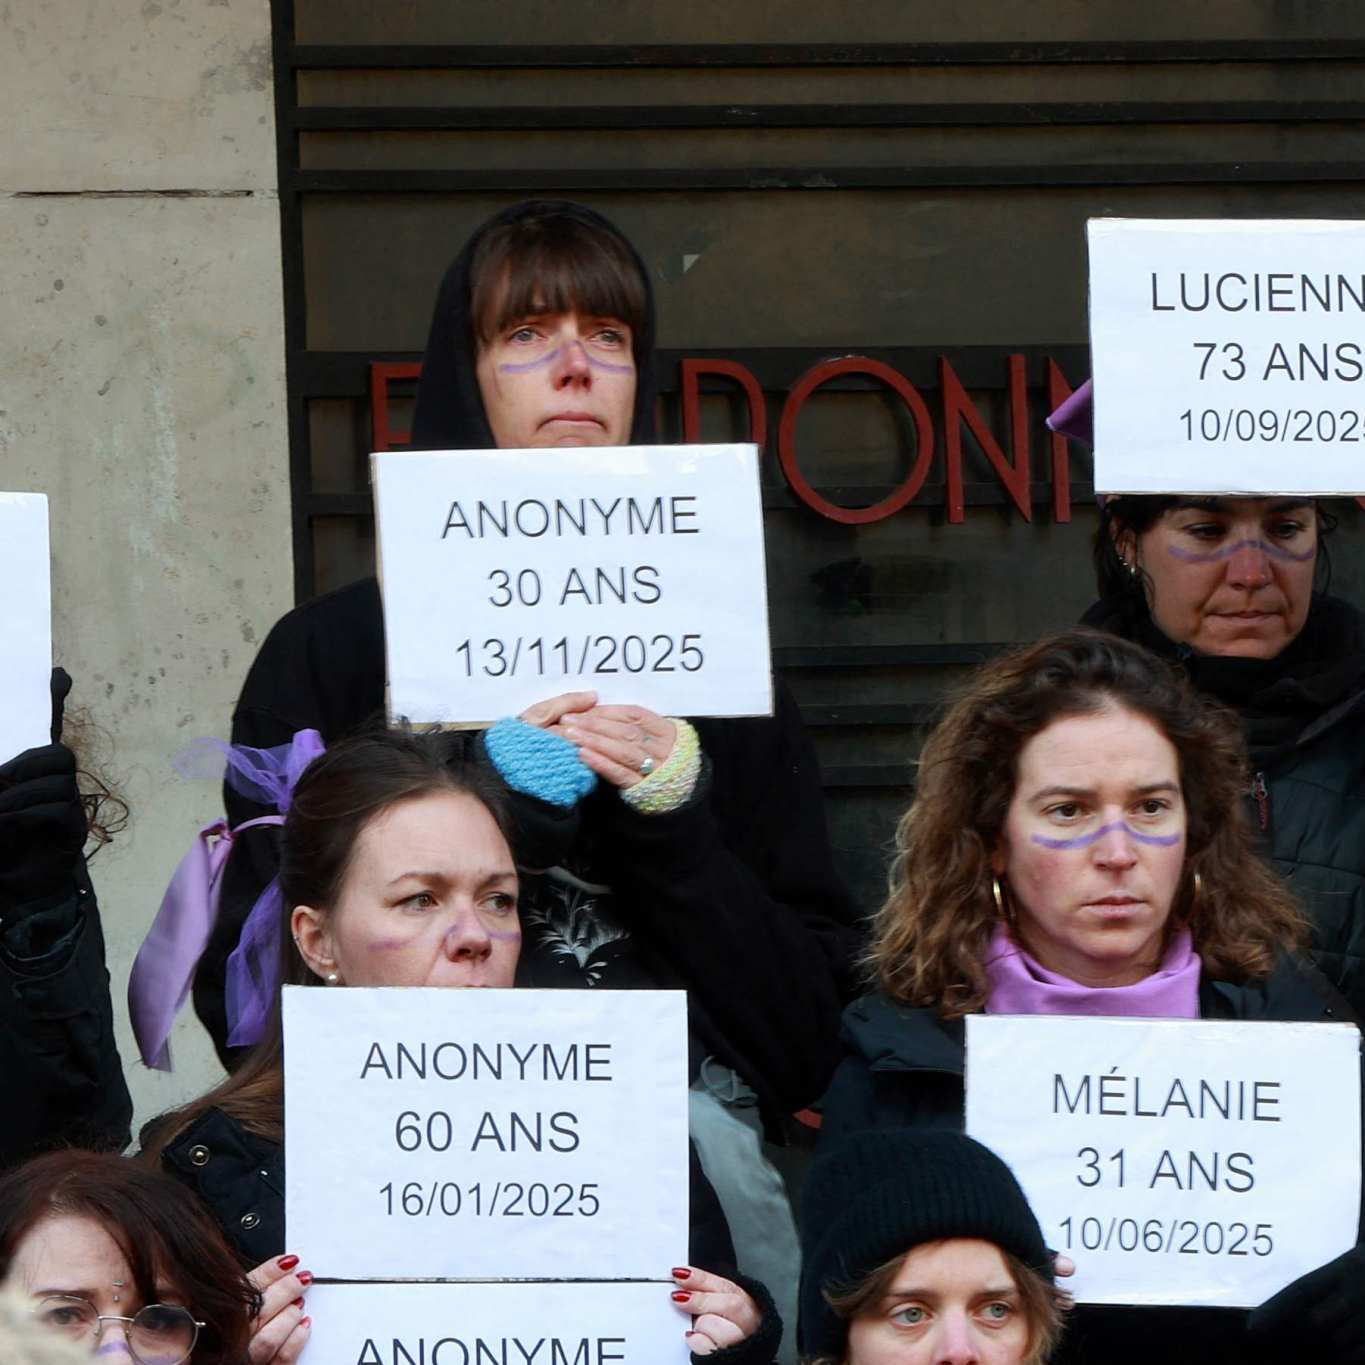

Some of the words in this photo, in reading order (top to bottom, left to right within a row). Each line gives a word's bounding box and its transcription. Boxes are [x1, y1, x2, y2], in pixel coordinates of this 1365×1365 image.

[1193, 342, 1246, 381] 73
[1262, 343, 1363, 382] ANS
[440, 496, 700, 539] ANONYME
[488, 568, 541, 607] 30
[559, 565, 661, 606] ANS
[456, 634, 704, 677] 13/11/2025
[360, 1042, 613, 1081] ANONYME
[1053, 1066, 1282, 1122] MÉLANIE
[396, 1111, 452, 1152] 60
[470, 1111, 580, 1153] ANS
[1077, 1147, 1125, 1188] 31
[1148, 1150, 1255, 1193] ANS
[379, 1181, 600, 1217] 16/01/2025
[1057, 1216, 1274, 1260] 10/06/2025
